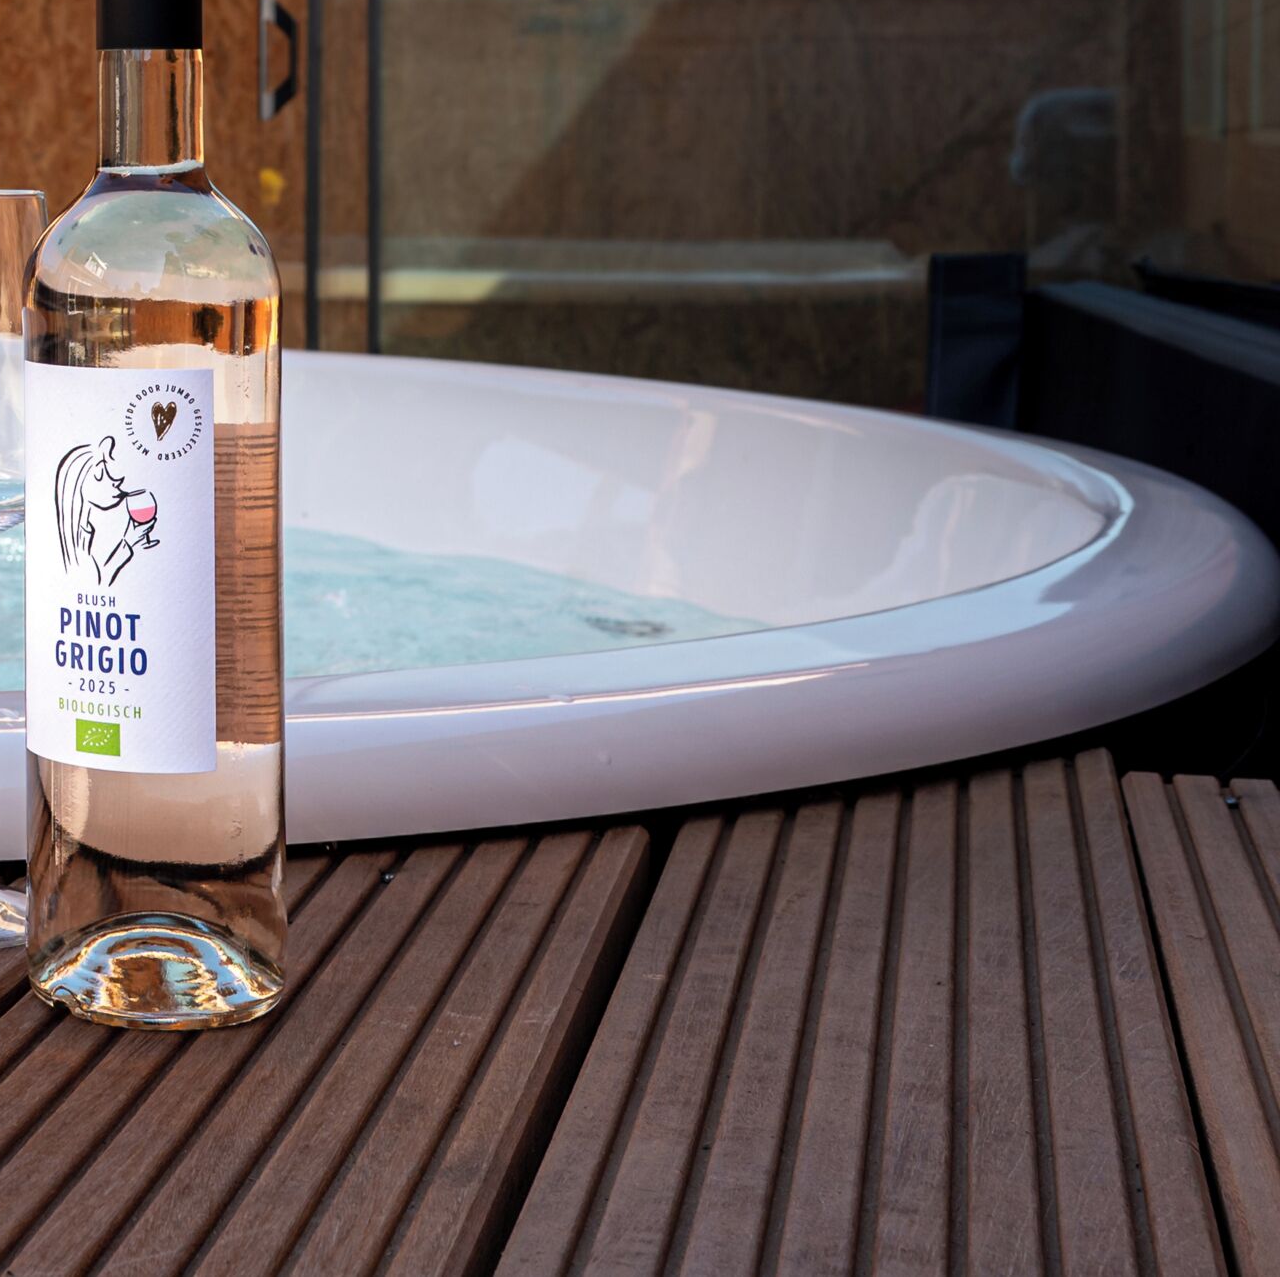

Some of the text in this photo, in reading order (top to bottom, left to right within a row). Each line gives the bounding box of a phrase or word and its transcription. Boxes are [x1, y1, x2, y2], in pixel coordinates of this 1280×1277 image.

[125, 384, 202, 461] MET LIEFDE DOOR JUMBO GESELECTEERD
[77, 593, 116, 608] BLUSH
[60, 607, 141, 642] PINOT
[55, 639, 148, 676] GRIGIO
[79, 677, 116, 695] 2025
[58, 697, 142, 720] BIOLOGISCH
